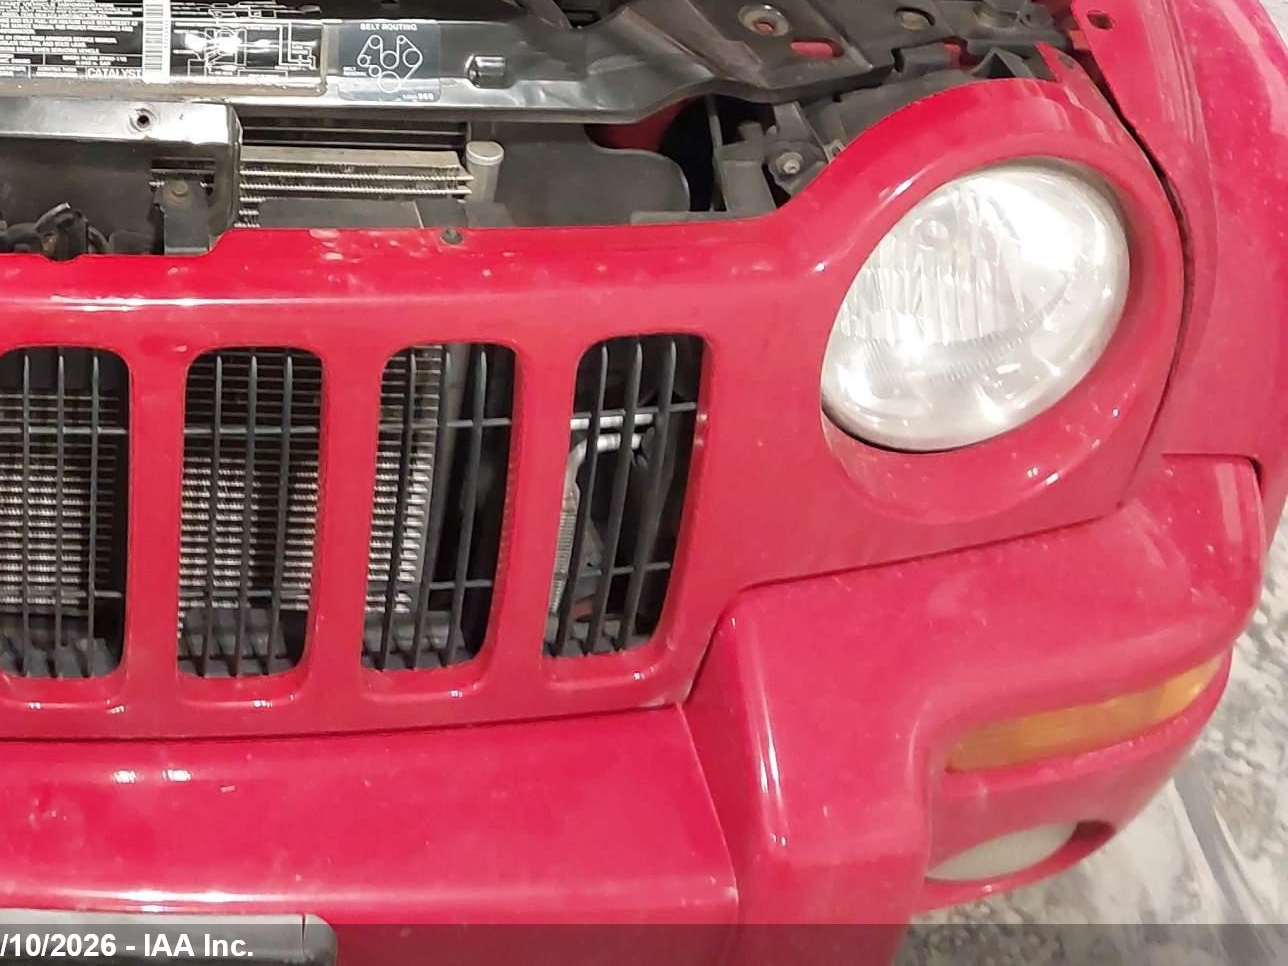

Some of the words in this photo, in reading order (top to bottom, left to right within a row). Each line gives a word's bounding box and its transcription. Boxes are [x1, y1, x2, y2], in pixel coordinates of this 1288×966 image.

[360, 23, 380, 31] BELT
[381, 23, 418, 31] ROUTING
[87, 68, 142, 79] CATALYST
